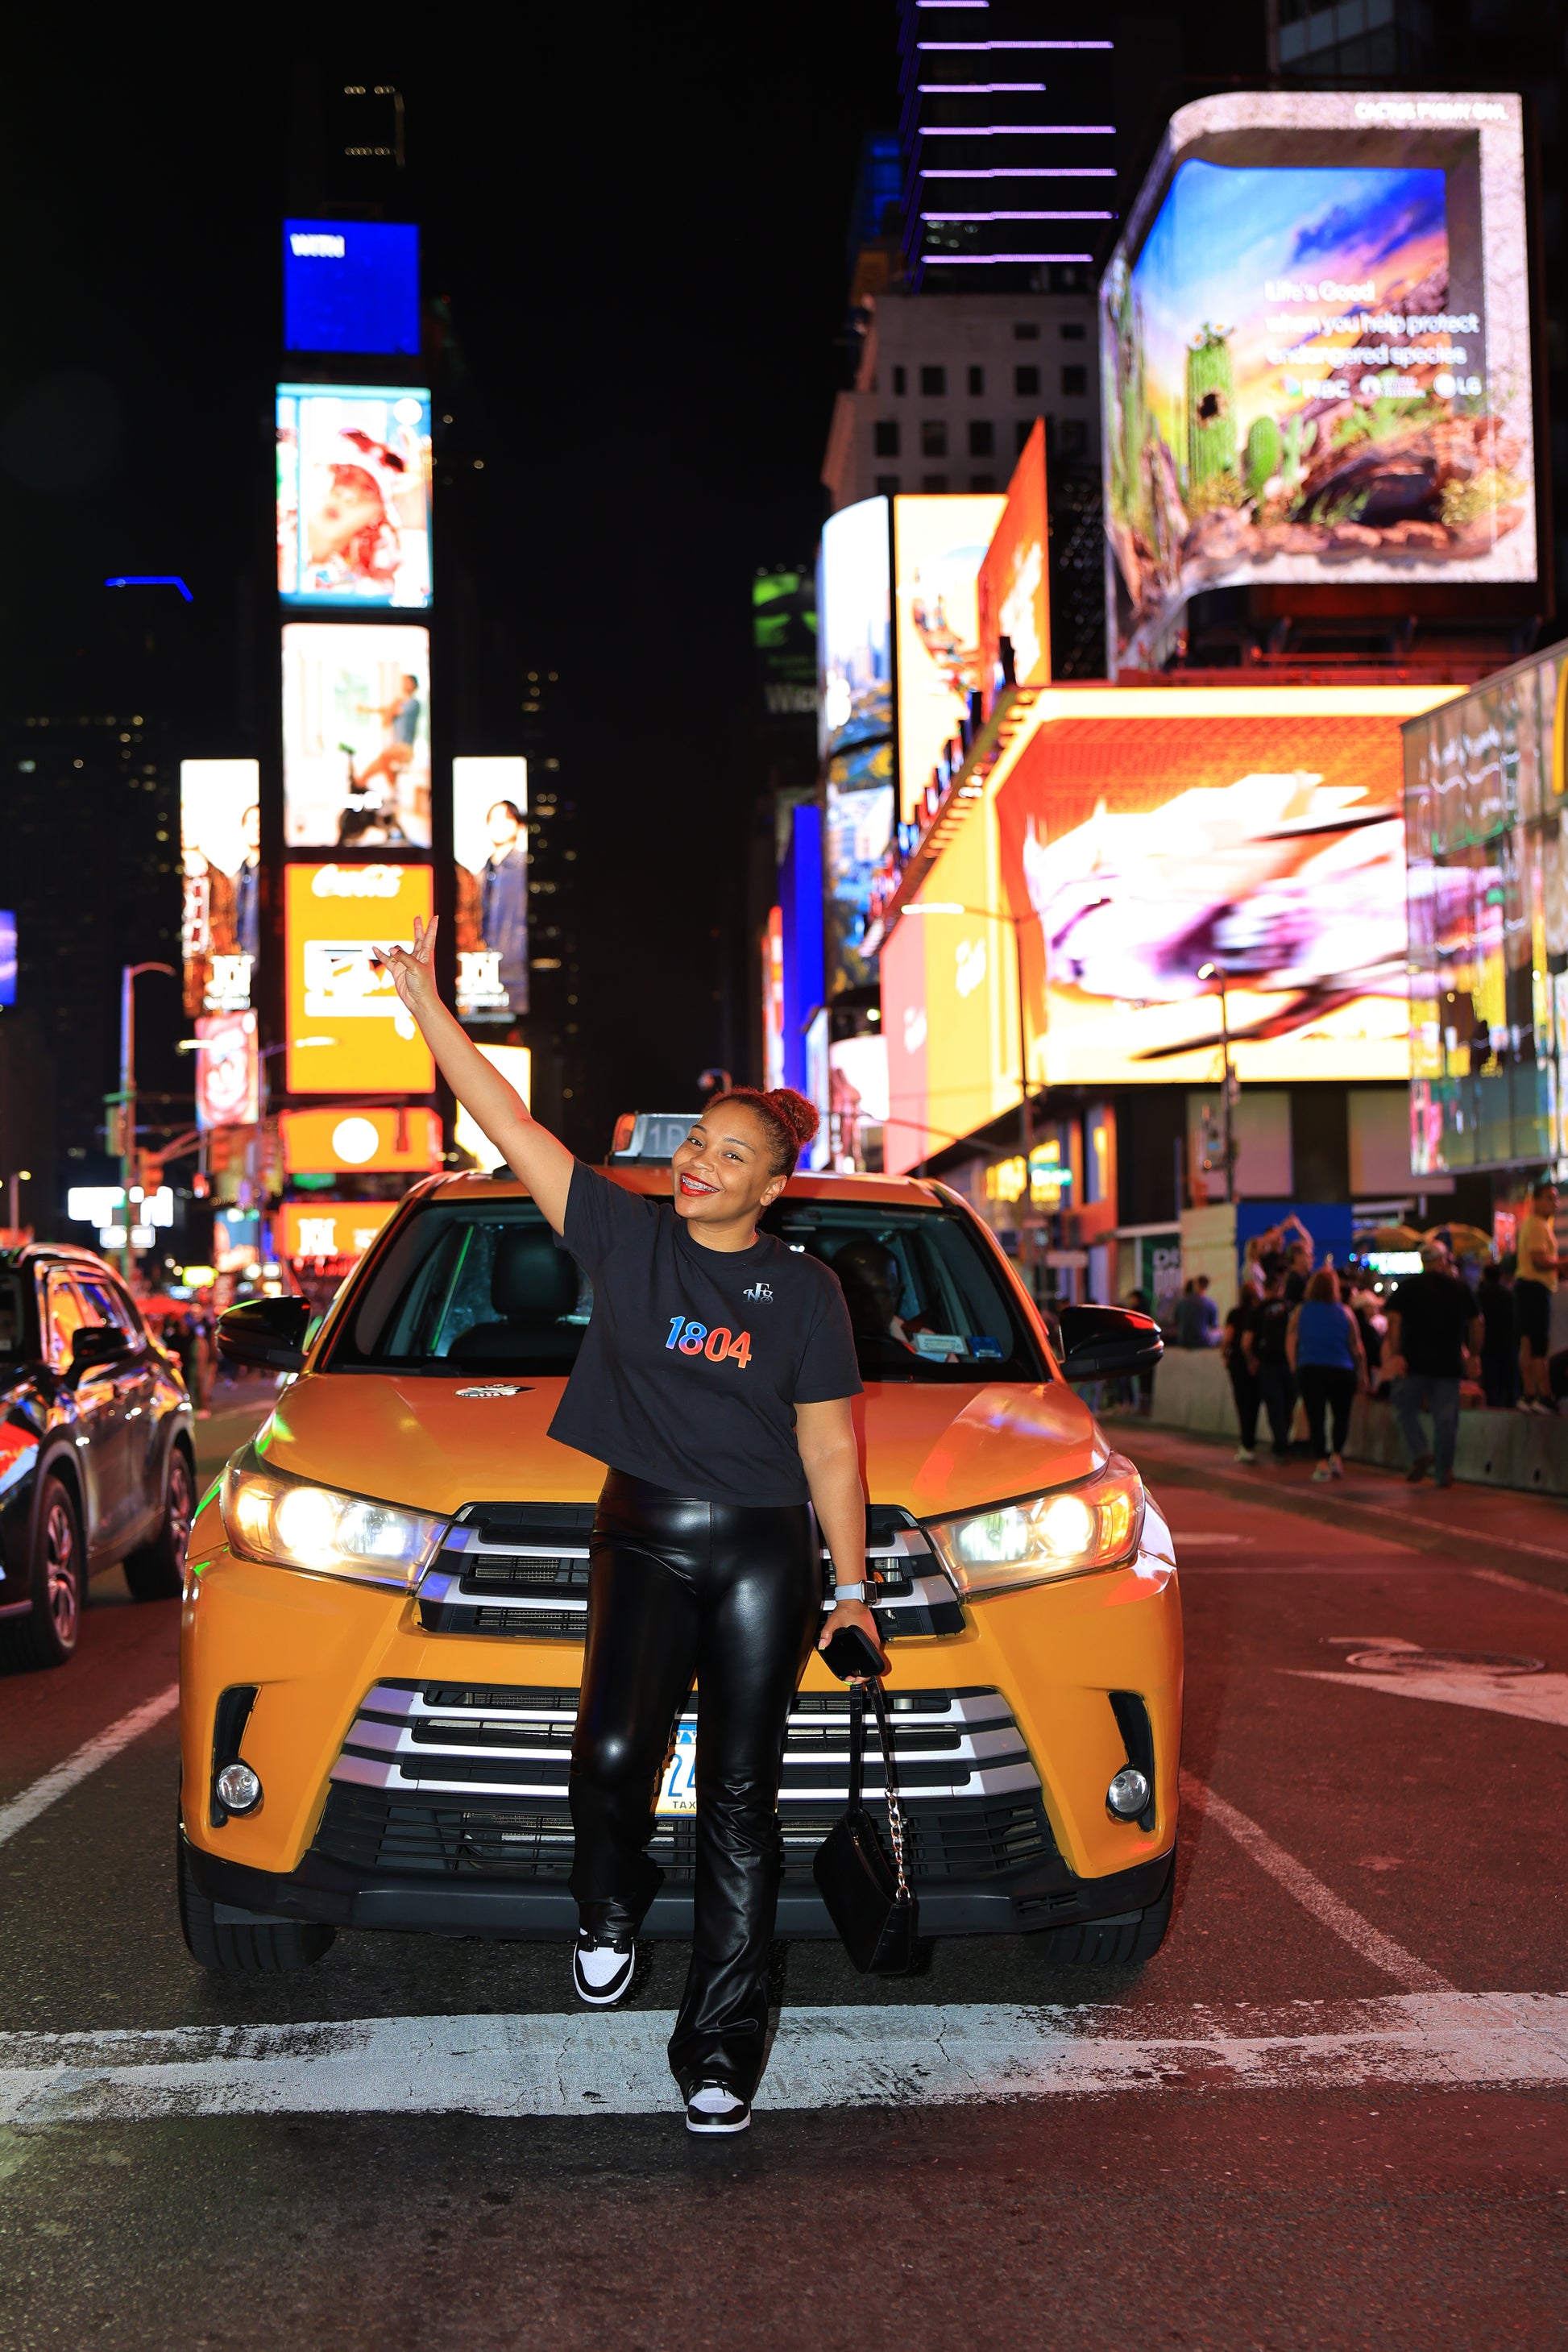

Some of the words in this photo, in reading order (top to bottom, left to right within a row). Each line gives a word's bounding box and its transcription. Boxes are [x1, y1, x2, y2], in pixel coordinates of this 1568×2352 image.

[1264, 280, 1318, 302] Life's
[1318, 280, 1375, 302] Good
[1265, 313, 1320, 334] when
[1321, 317, 1360, 337] you
[1360, 311, 1405, 338] help
[1406, 313, 1480, 337] protect
[1266, 343, 1388, 369] endangered
[1389, 343, 1467, 368] species
[1456, 376, 1482, 396] LG
[666, 1315, 753, 1369] 1804
